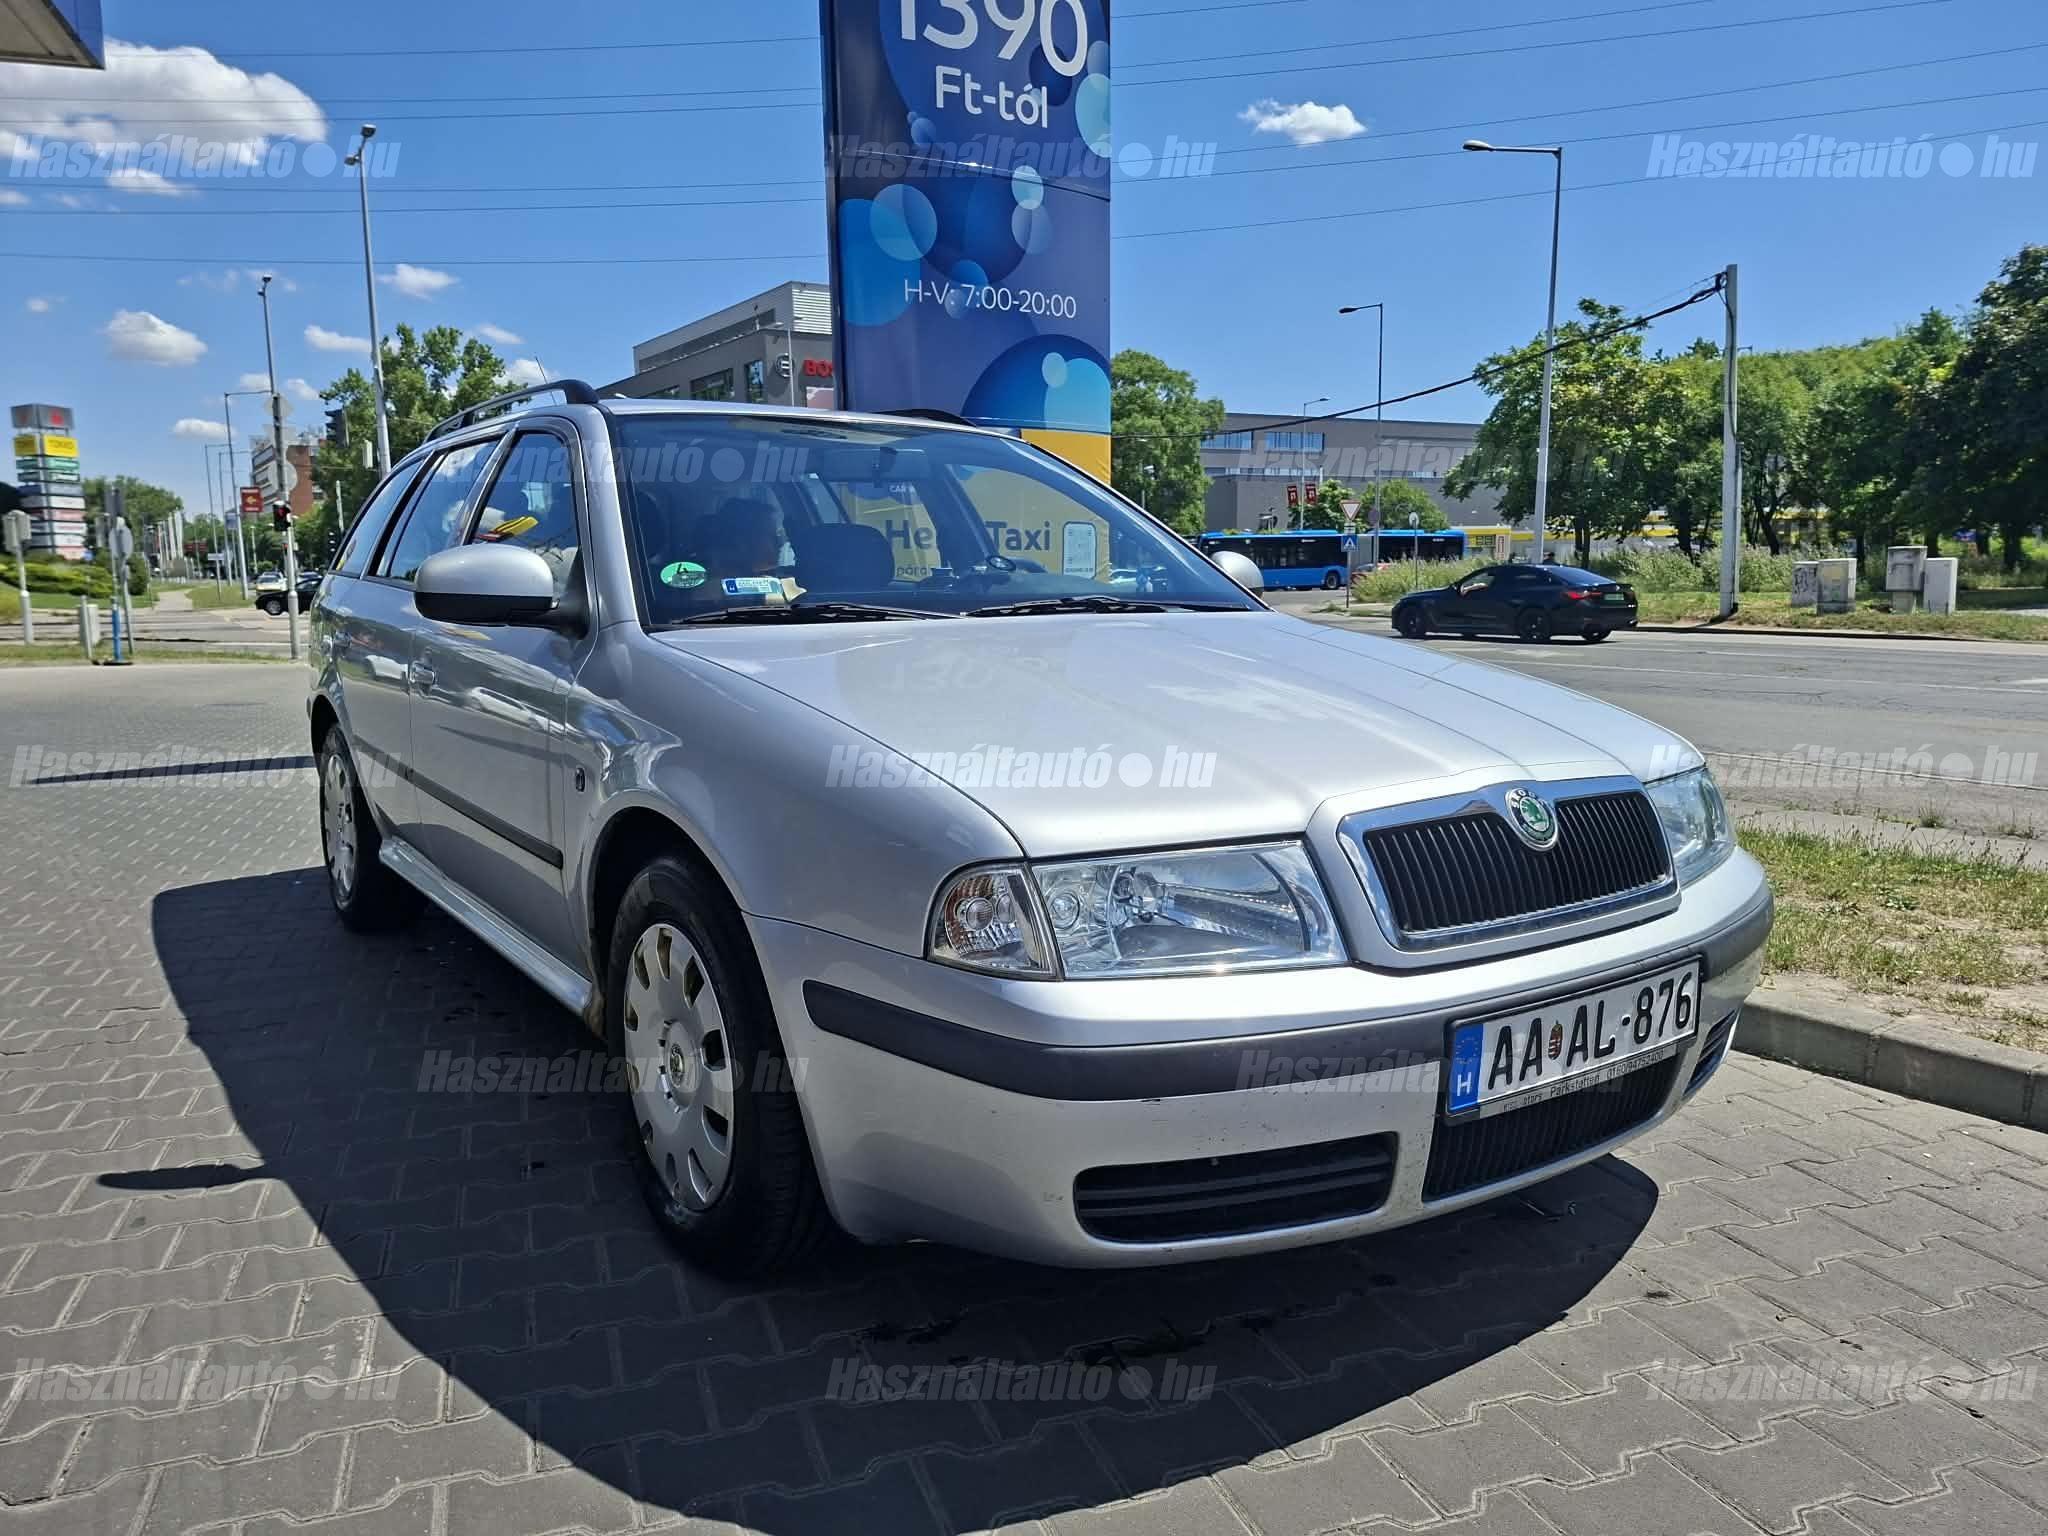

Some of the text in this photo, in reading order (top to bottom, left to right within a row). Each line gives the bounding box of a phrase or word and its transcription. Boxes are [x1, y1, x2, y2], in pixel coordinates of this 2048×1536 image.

[935, 65, 1047, 128] Ft-tól
[960, 283, 1077, 319] 7:00-20:00
[884, 519, 934, 550] He
[984, 520, 1051, 551] Taxi
[1456, 1070, 1473, 1097] H
